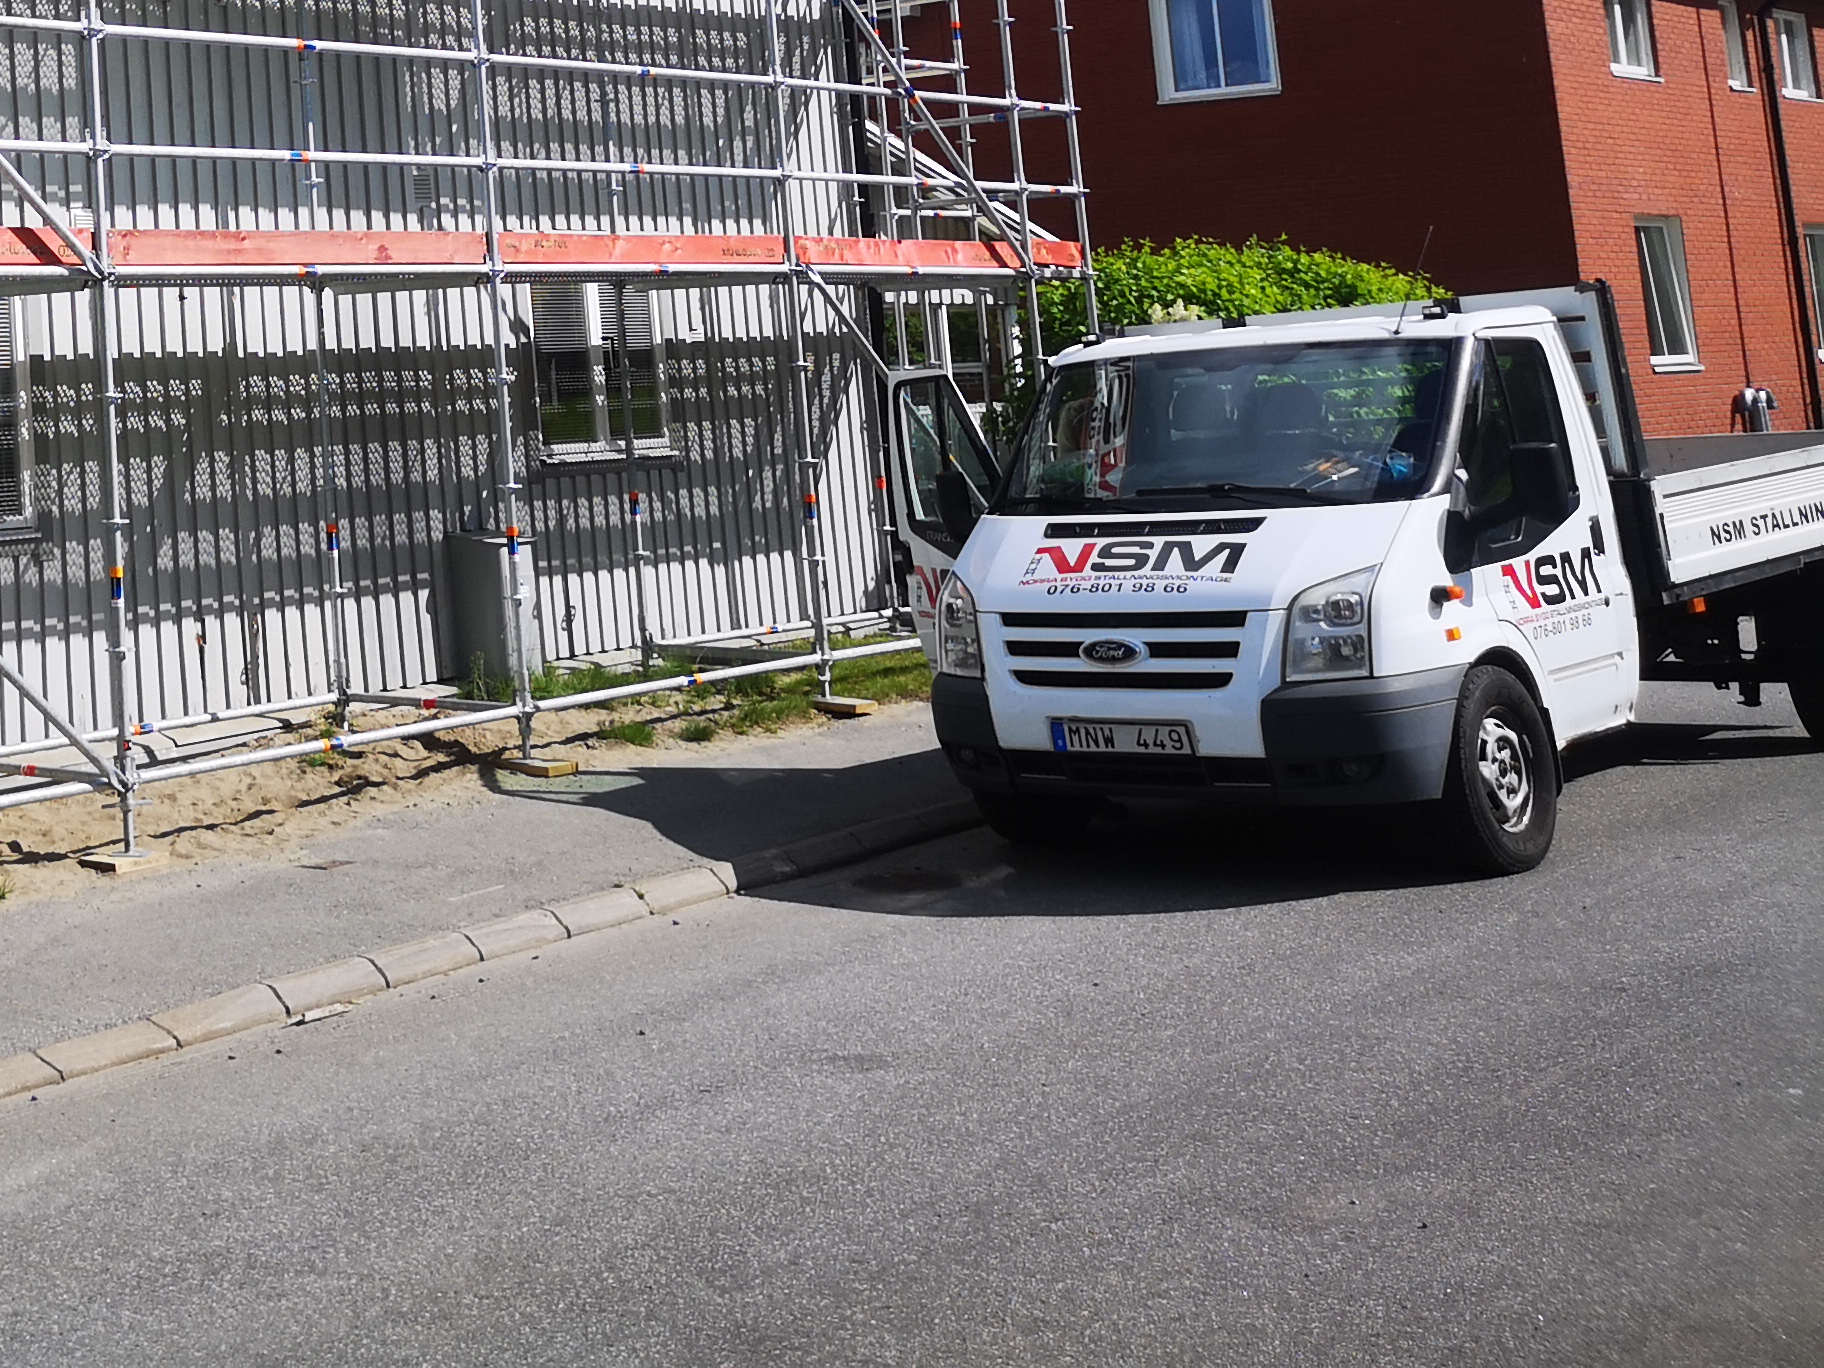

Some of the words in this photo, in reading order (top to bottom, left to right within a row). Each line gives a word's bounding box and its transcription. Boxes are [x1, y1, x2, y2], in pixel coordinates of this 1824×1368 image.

[1709, 519, 1747, 546] NSM
[1035, 540, 1248, 574] NSM
[1047, 582, 1123, 595] 076-801
[1131, 582, 1156, 593] 98
[1163, 583, 1189, 594] 66
[1501, 546, 1602, 610] NSM
[1092, 643, 1125, 659] Ford
[1067, 725, 1116, 749] MNW
[1136, 728, 1184, 751] 449
